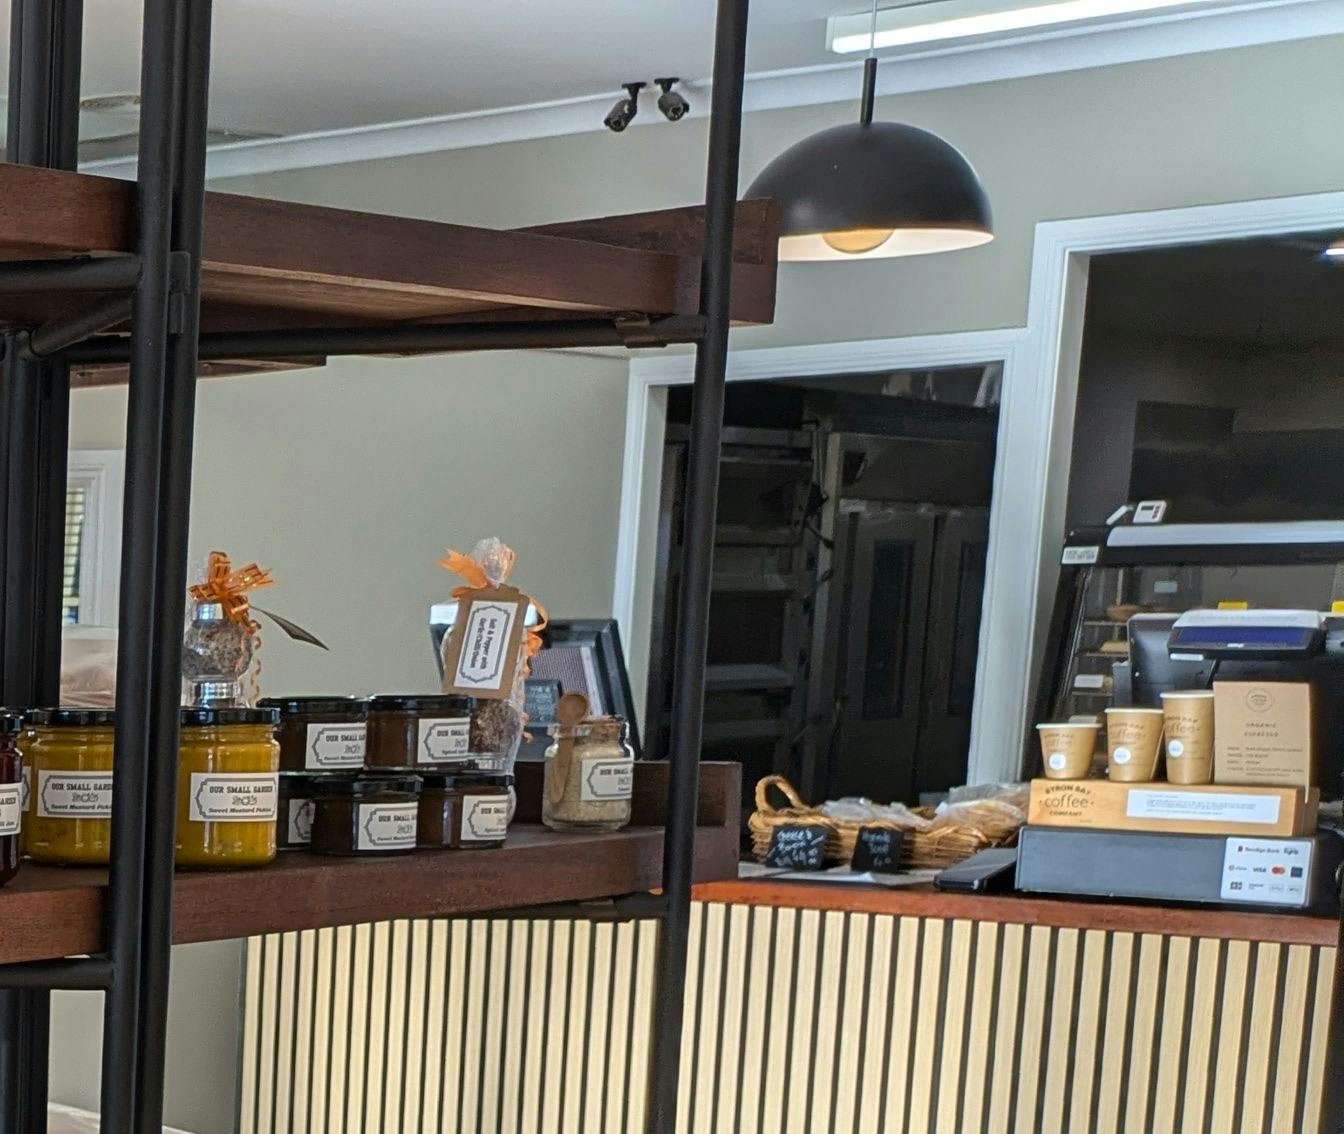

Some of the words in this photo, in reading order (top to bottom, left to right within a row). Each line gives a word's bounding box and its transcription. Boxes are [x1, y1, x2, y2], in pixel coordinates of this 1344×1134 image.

[51, 783, 64, 791] OUR
[66, 783, 92, 791] SMALL
[209, 786, 224, 794] OUR
[226, 786, 251, 794] SMALL
[1045, 784, 1072, 794] BYRON
[1044, 794, 1088, 809] coffee
